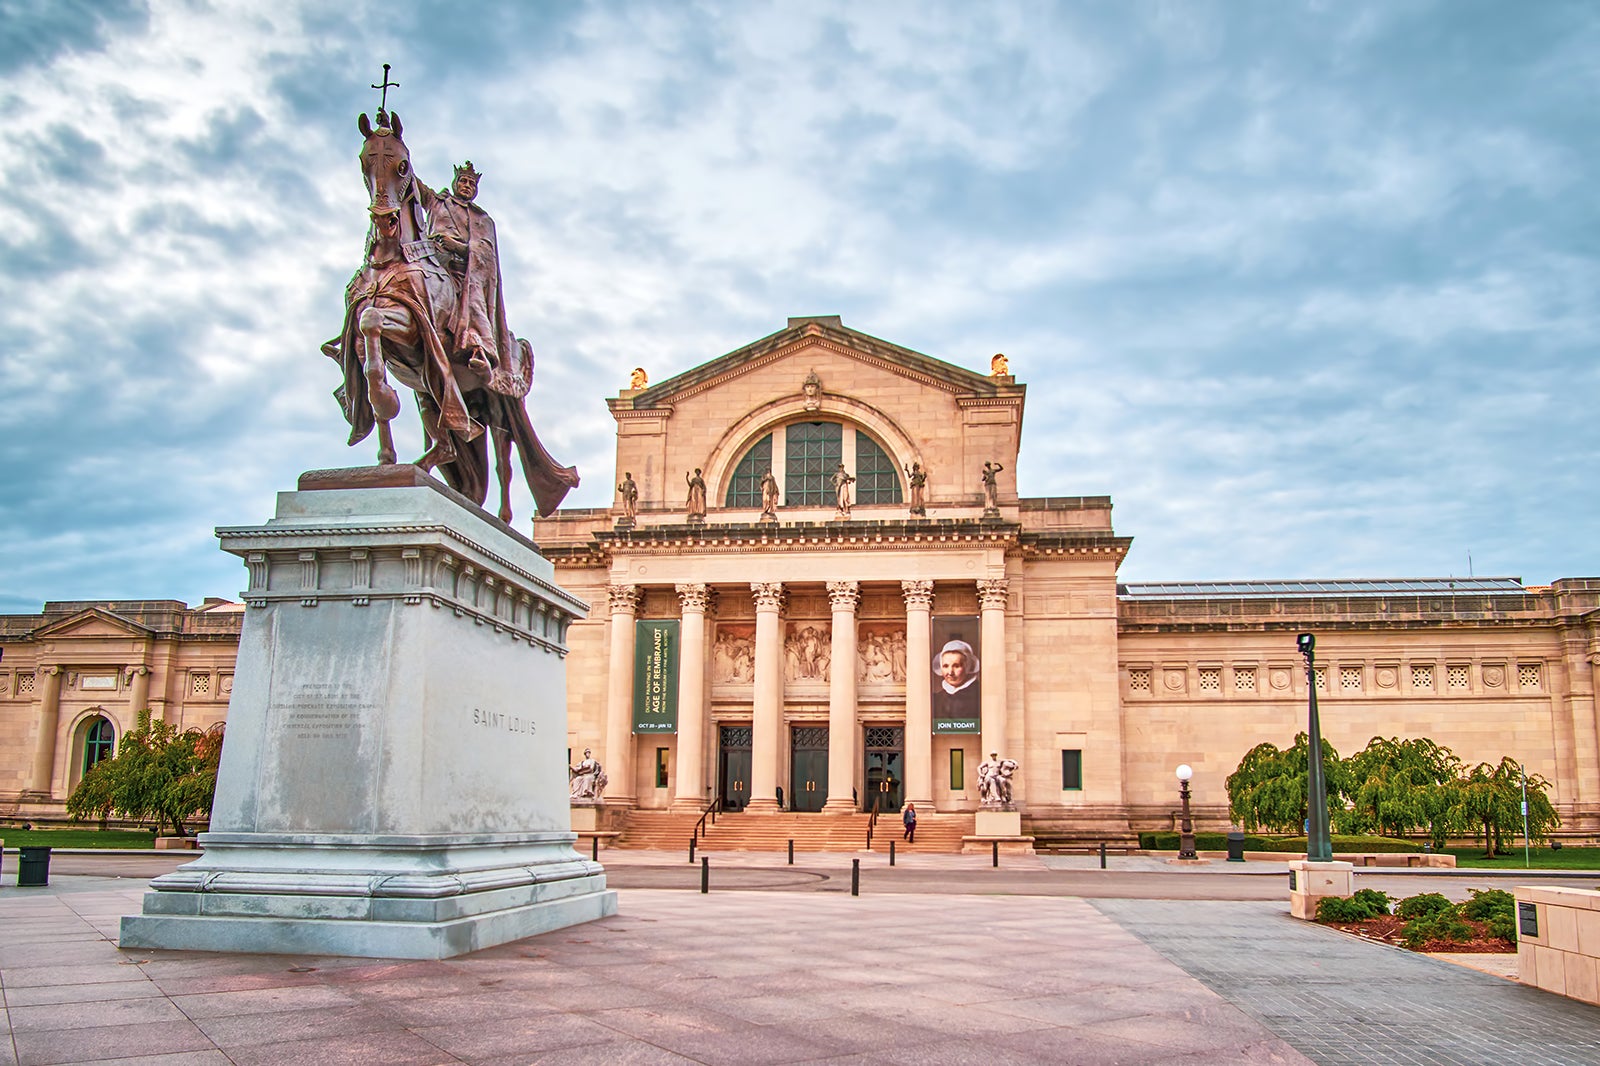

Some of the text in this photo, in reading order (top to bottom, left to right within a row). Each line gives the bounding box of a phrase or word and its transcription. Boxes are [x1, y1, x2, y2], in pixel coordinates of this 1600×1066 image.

[653, 680, 660, 694] OF
[474, 708, 536, 736] SAINT LOUIS
